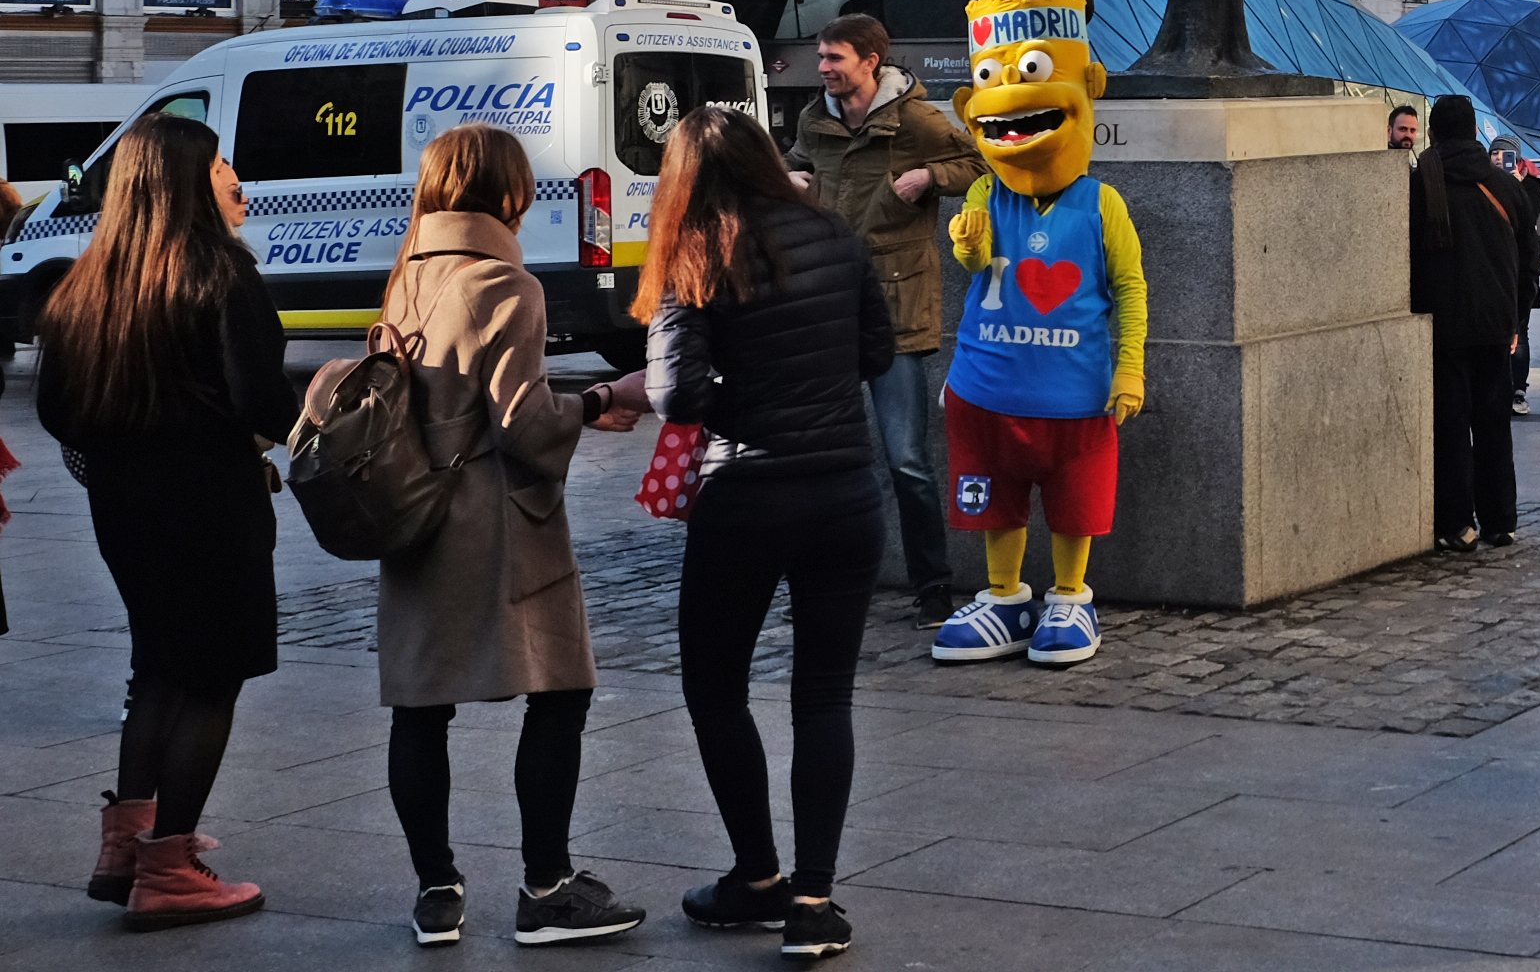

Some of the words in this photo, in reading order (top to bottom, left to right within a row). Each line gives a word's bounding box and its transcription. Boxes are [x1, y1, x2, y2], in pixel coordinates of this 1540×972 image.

[284, 42, 332, 63] OFICINA
[334, 42, 354, 61] DE
[353, 36, 417, 60] ATENCIÓN
[417, 37, 434, 57] AL
[437, 34, 516, 56] CIUDADANO
[686, 36, 740, 51] ASSISTANCE
[924, 56, 970, 70] PlayRenfe
[405, 75, 555, 112] POLICÍA
[325, 111, 357, 136] 112
[459, 110, 551, 125] MUNICIPAL
[505, 125, 551, 135] MADRID
[1093, 123, 1128, 146] OL
[626, 182, 658, 197] OFICIN
[364, 217, 411, 238] ASS
[628, 212, 650, 229] PO
[266, 241, 363, 265] POLICE
[980, 256, 1011, 310] I
[978, 323, 1080, 348] MADRID
